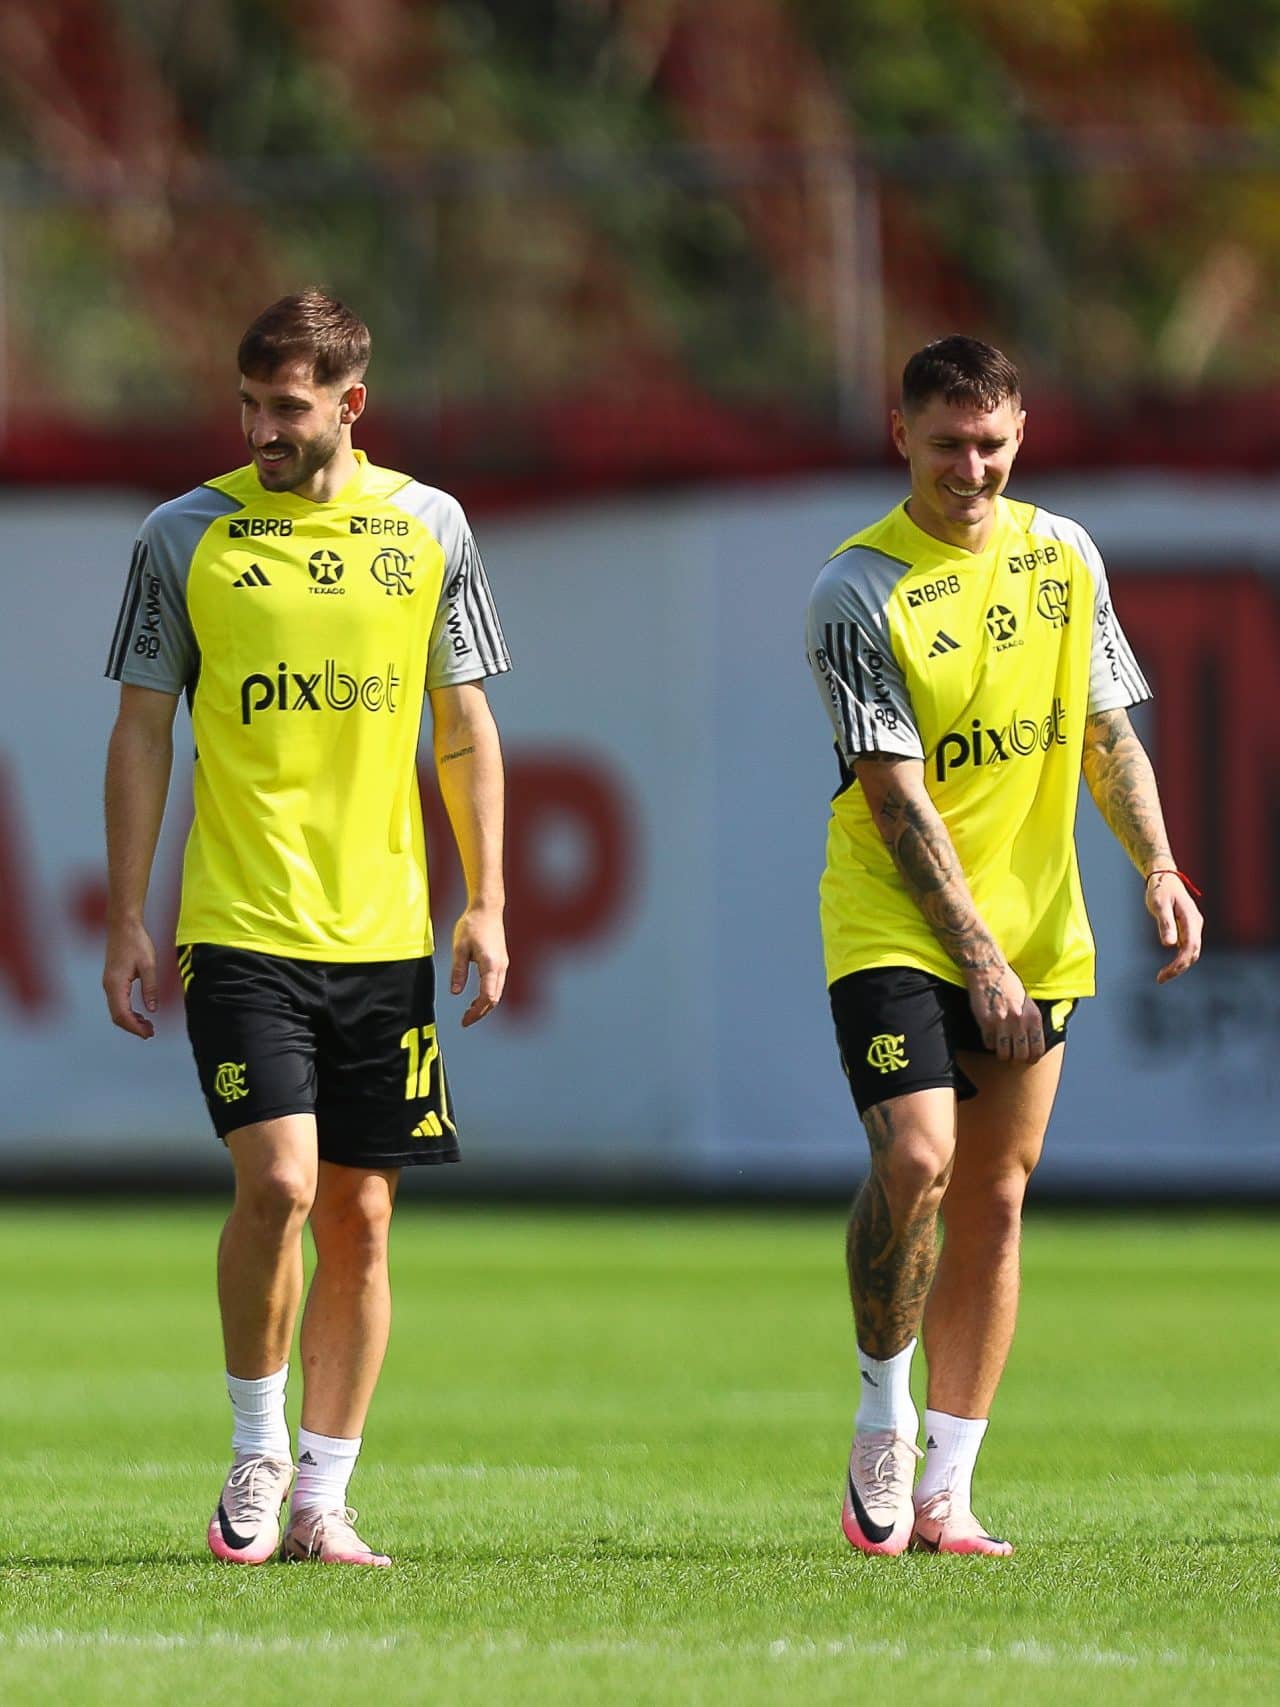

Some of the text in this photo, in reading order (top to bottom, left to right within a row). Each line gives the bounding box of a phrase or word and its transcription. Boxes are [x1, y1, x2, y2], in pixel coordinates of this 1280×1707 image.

[250, 518, 294, 537] BRB
[370, 518, 410, 536] BRB
[1023, 546, 1058, 571] BRB
[308, 586, 346, 595] TEXACO
[923, 574, 961, 602] BRB
[141, 573, 162, 633] kwai
[240, 659, 401, 725] pixbet
[935, 696, 1067, 783] pixbet
[399, 1022, 440, 1101] 17
